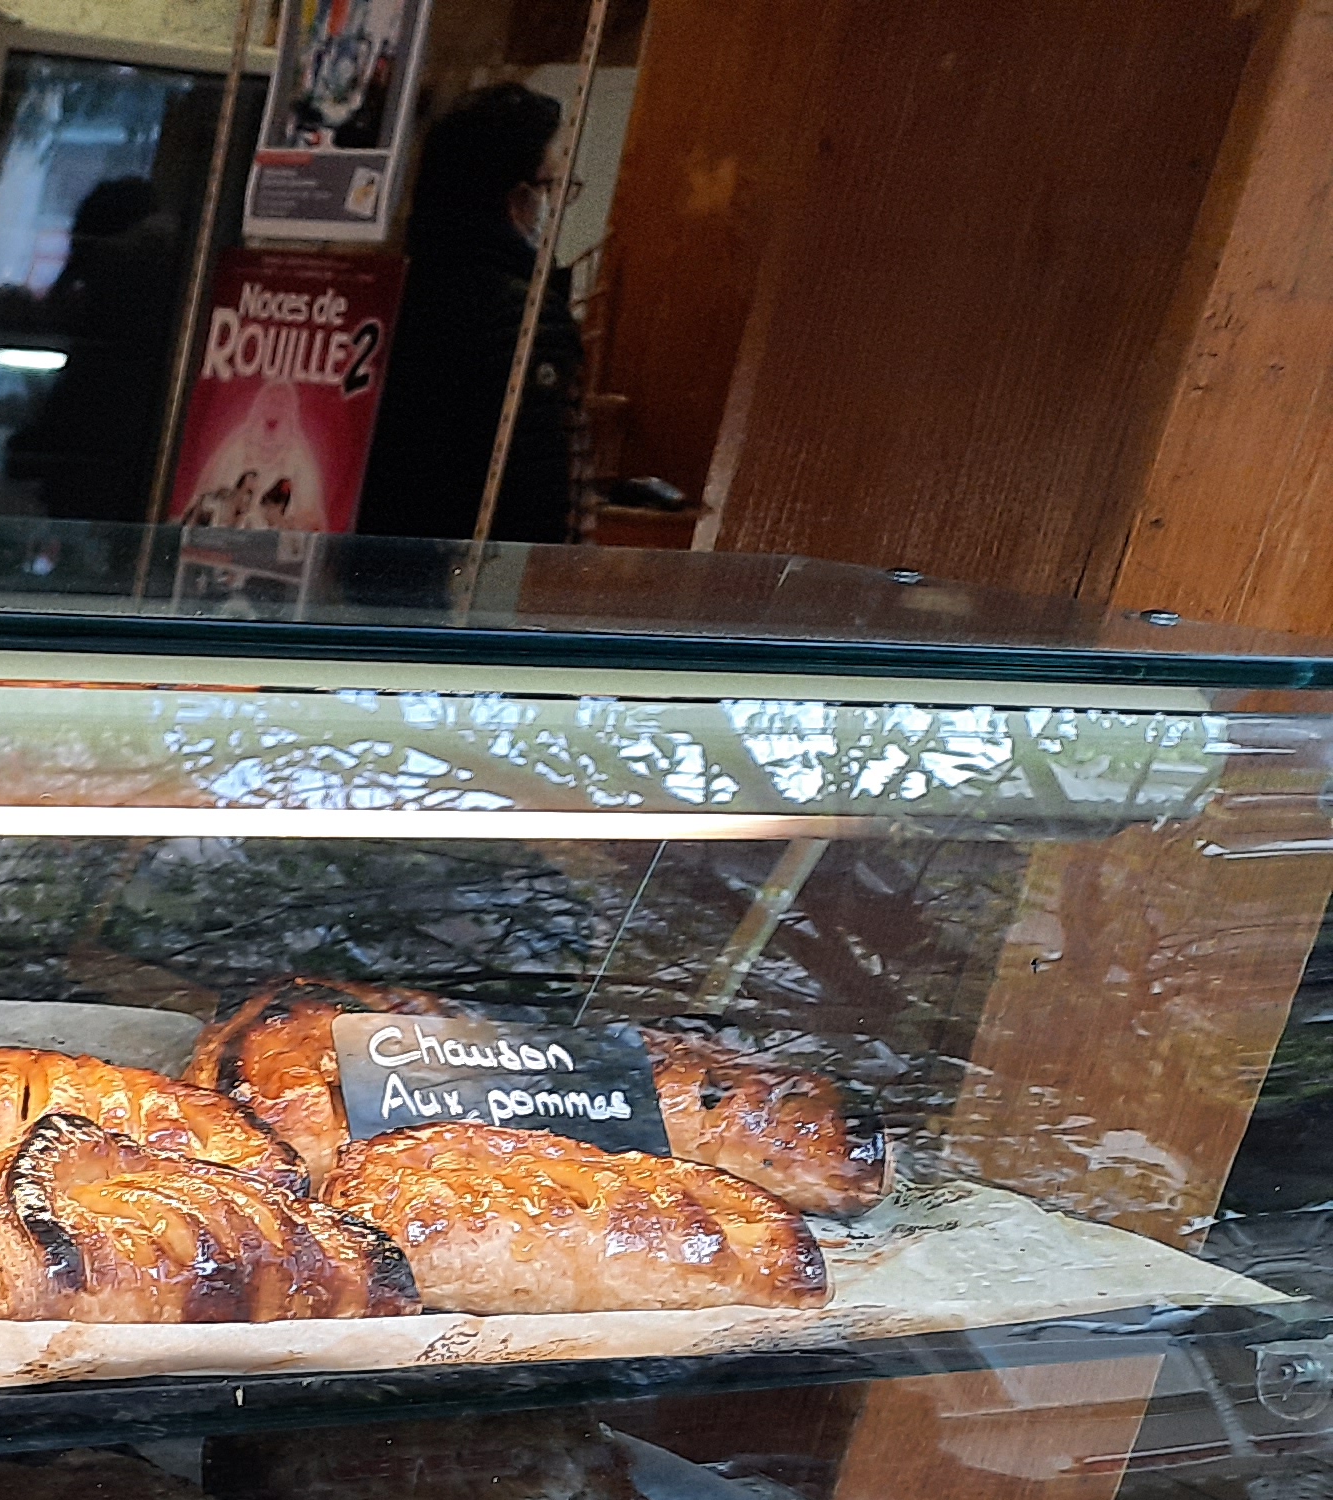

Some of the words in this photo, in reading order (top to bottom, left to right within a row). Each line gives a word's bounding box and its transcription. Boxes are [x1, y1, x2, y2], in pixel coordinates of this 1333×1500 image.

[238, 282, 311, 322] Noces
[311, 288, 349, 326] de
[381, 1072, 463, 1120] Aux
[487, 1088, 633, 1127] pommes
